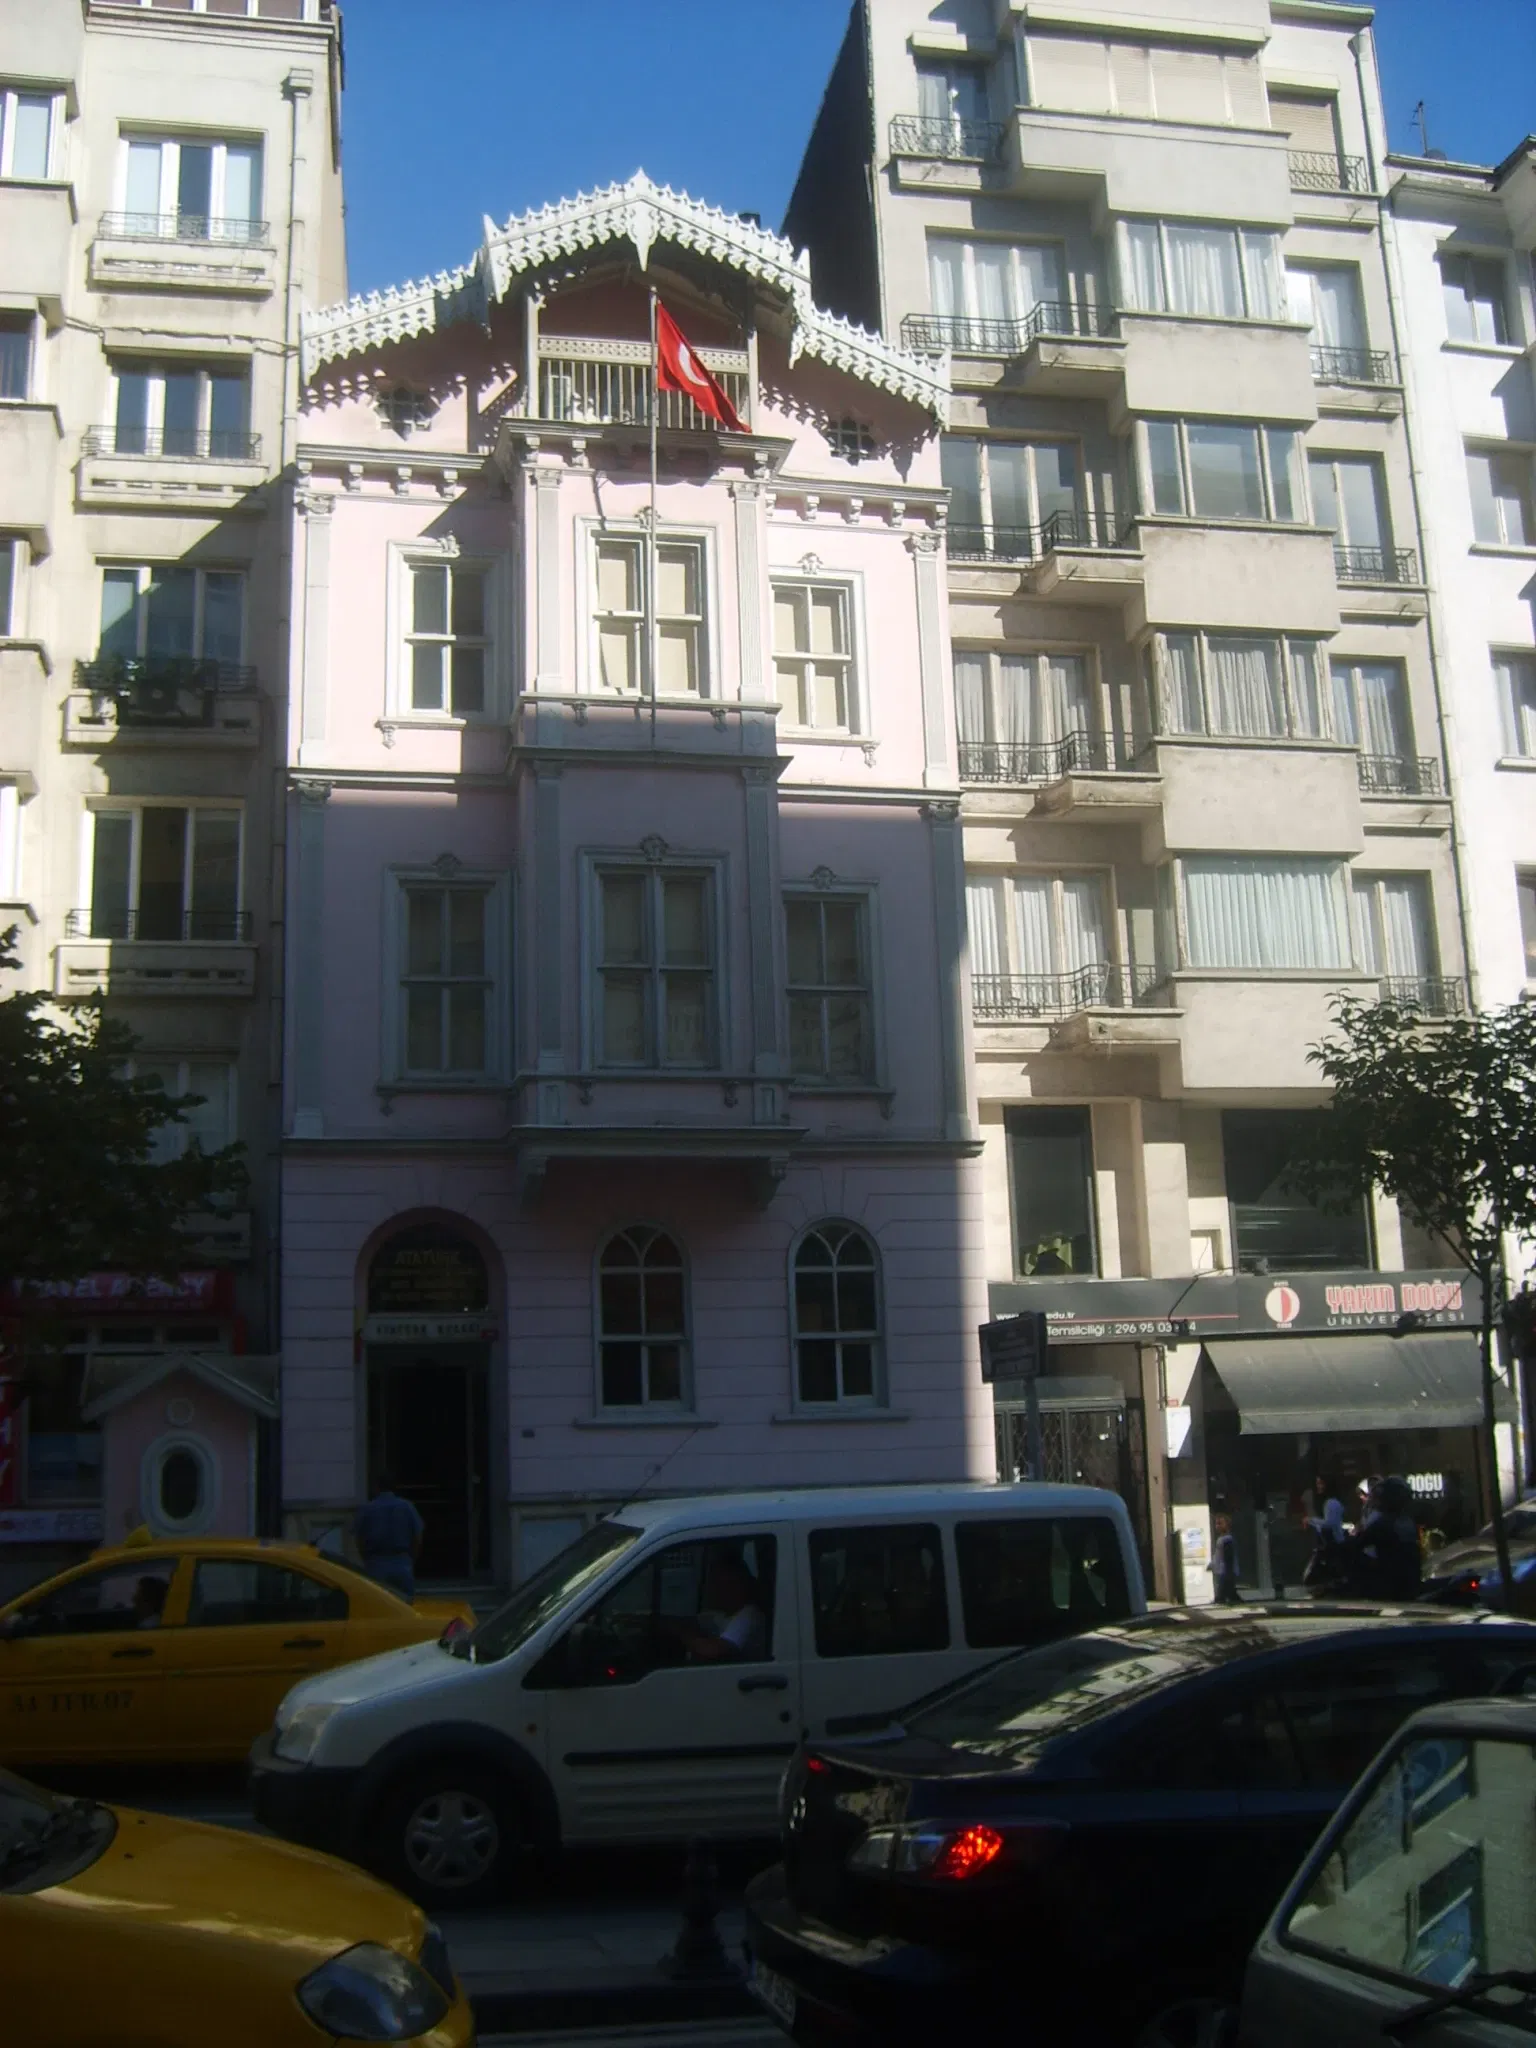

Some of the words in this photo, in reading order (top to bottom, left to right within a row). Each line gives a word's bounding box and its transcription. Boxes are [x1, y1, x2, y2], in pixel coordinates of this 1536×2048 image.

[1325, 1283, 1396, 1314] YAKIN
[1115, 1323, 1137, 1335] 296
[1139, 1322, 1155, 1334] 95
[1157, 1322, 1173, 1333] 03
